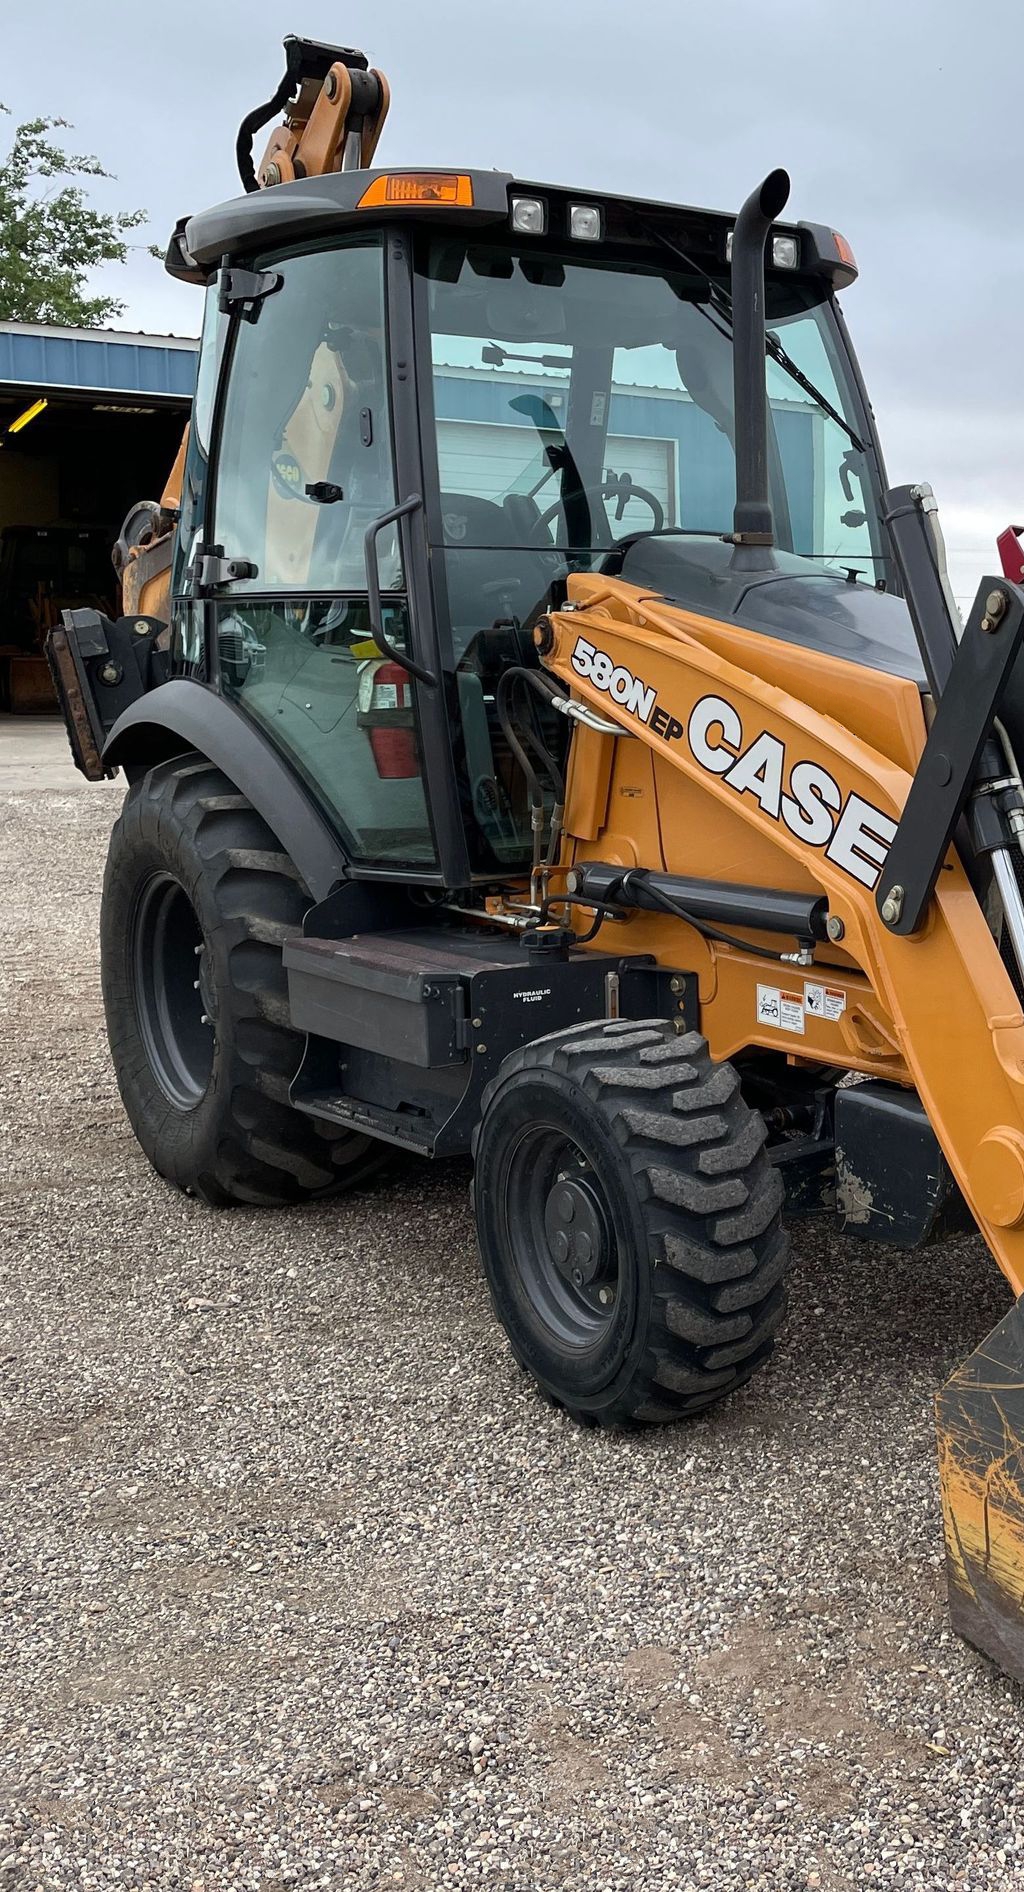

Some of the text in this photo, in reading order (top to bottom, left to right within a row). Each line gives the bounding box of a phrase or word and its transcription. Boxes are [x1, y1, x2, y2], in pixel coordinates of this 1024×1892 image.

[571, 635, 684, 741] 580N EP
[687, 694, 900, 892] CASE
[513, 989, 551, 999] HYDRAULIC
[522, 995, 543, 1003] FLUID
